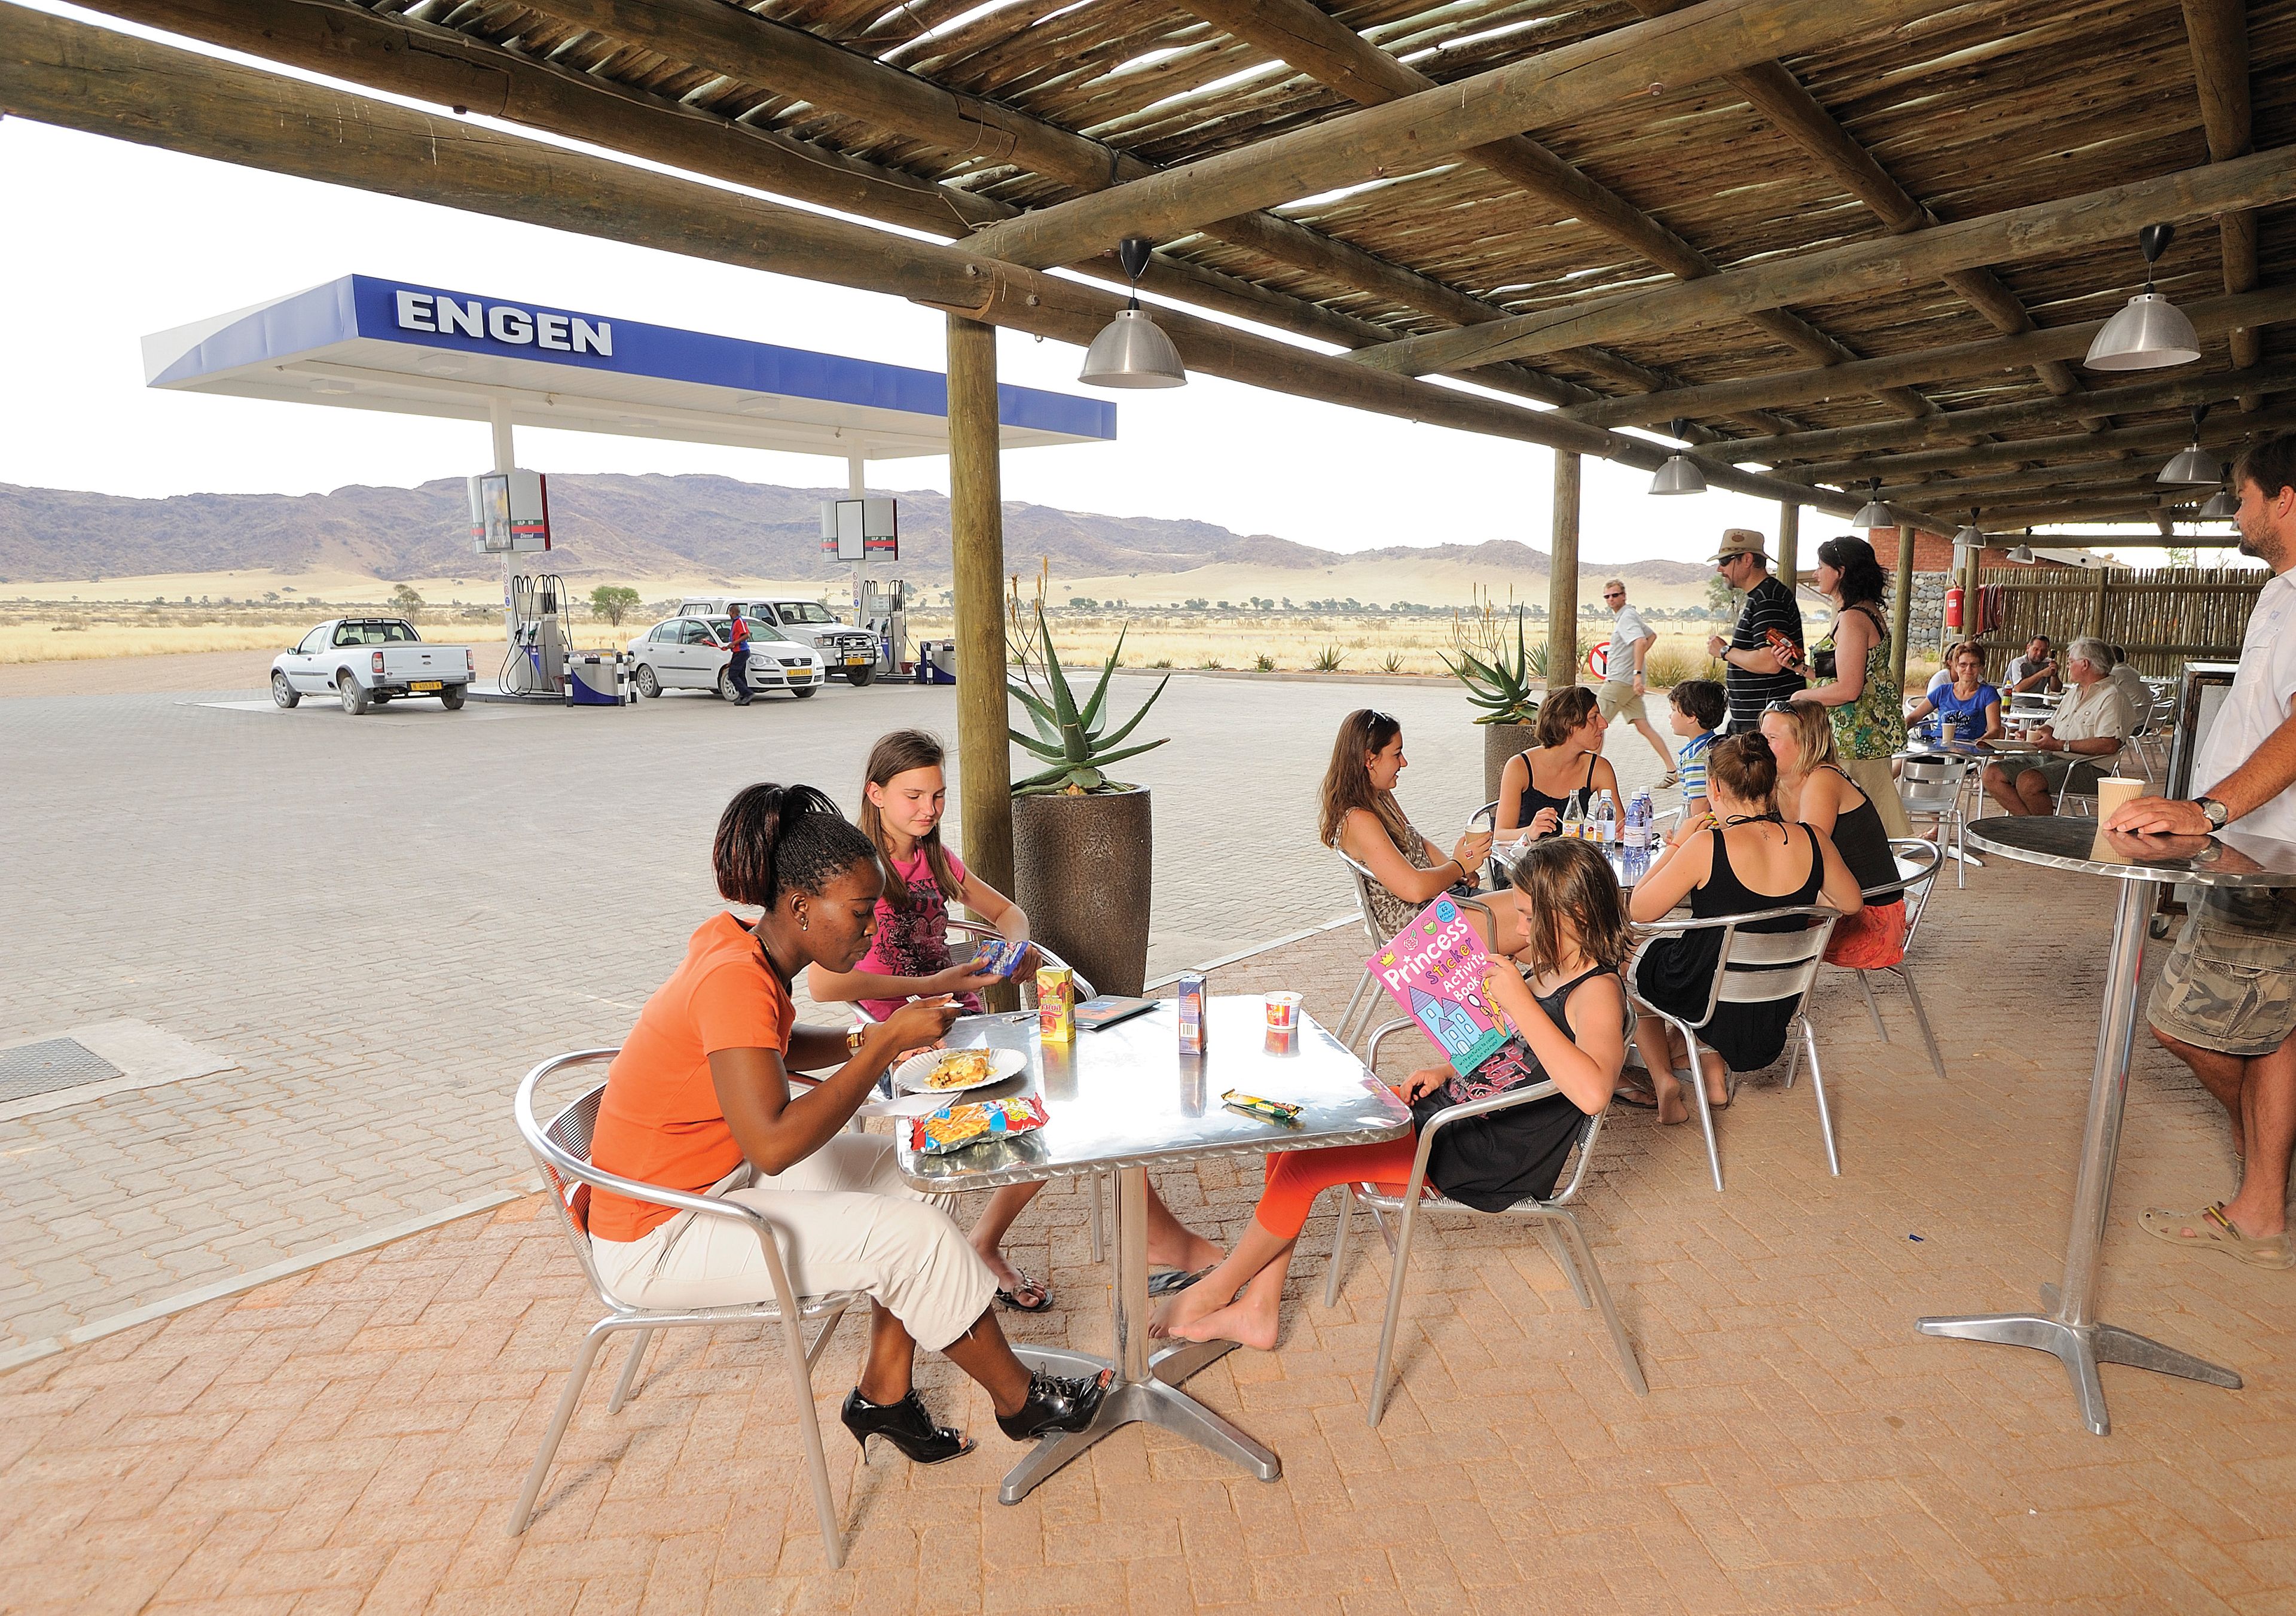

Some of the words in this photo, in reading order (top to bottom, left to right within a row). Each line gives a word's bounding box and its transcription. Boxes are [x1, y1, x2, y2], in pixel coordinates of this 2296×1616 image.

[396, 290, 613, 356] ENGEN
[1382, 916, 1468, 992] Princess
[1425, 937, 1474, 984] Sticker
[1442, 952, 1488, 993] Activity
[1452, 976, 1481, 1002] Book
